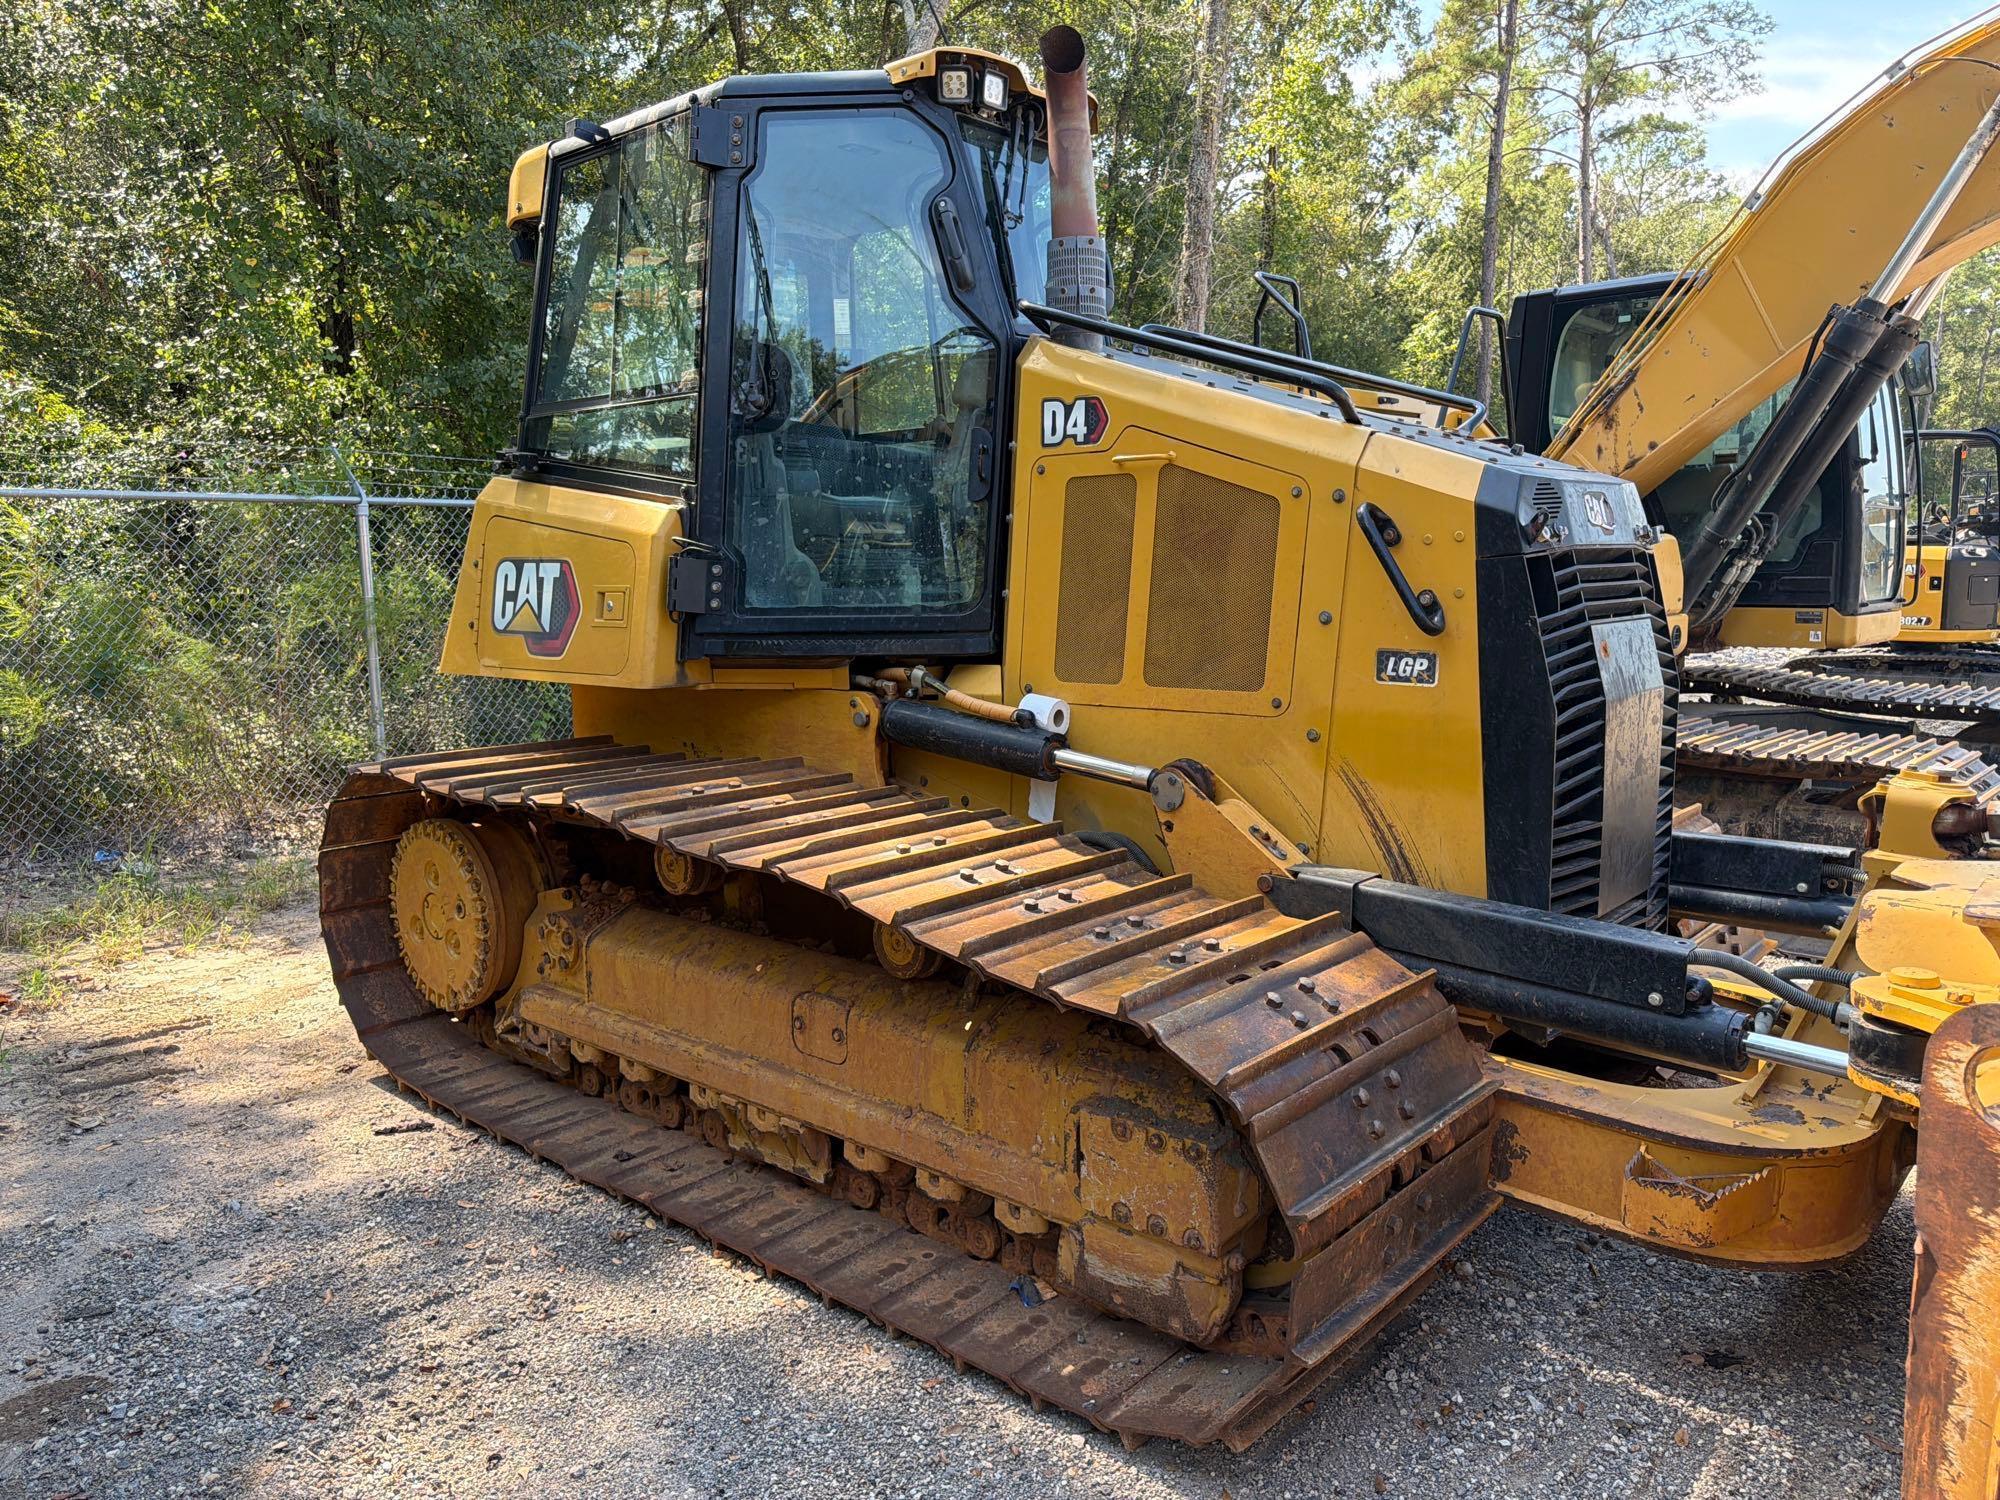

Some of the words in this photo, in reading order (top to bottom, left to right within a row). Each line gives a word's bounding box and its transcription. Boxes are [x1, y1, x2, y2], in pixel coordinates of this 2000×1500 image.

[1043, 399, 1087, 445] D4
[493, 560, 561, 633] CAT
[1386, 656, 1429, 677] LGP
